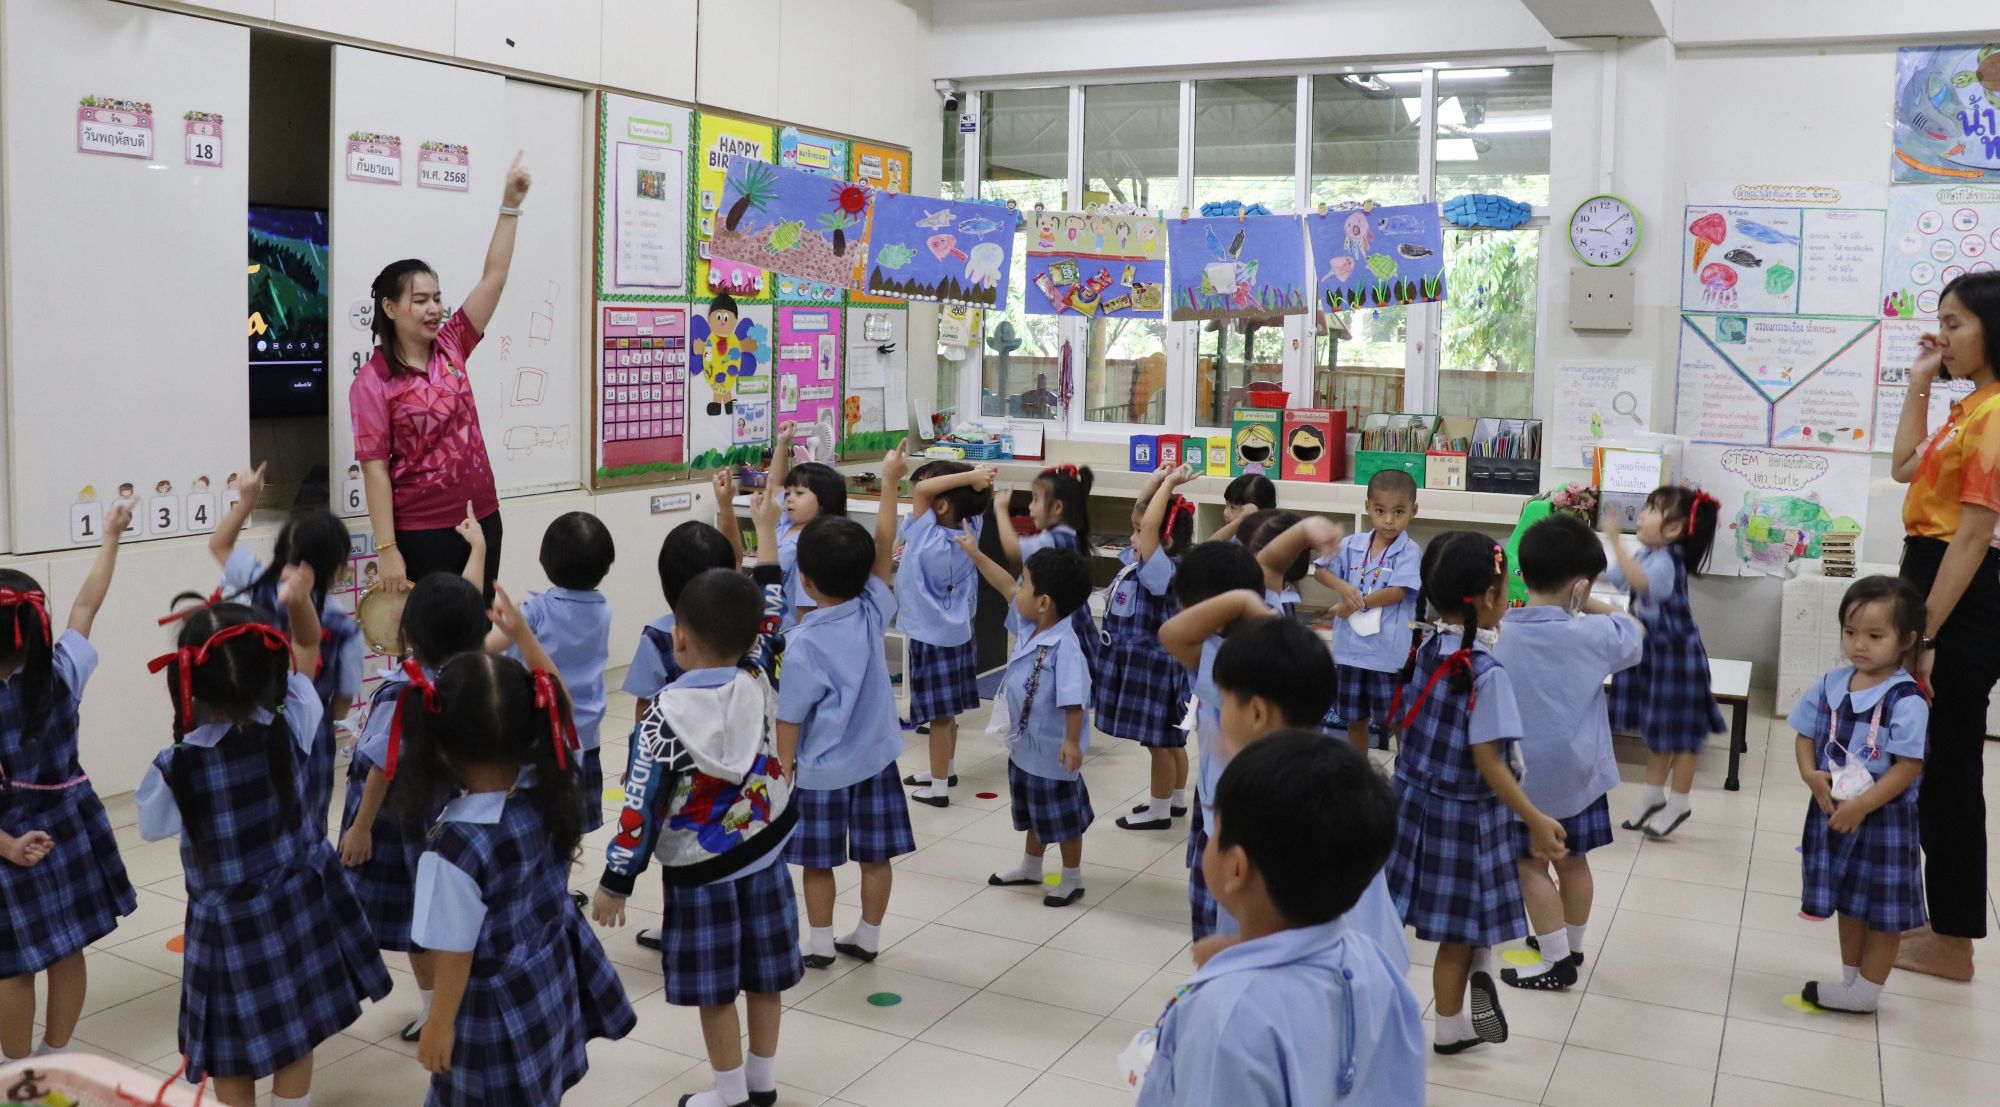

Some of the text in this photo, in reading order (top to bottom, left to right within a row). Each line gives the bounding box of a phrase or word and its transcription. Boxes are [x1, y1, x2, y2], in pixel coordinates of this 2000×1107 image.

[84, 126, 145, 148] วันพฤหัสบดี
[195, 144, 213, 159] 18
[719, 136, 760, 158] HAPPY
[709, 150, 729, 169] BIR
[357, 157, 394, 176] กันยายน
[422, 169, 466, 183] พ.ศ. 2568
[1589, 205, 1597, 213] 11
[1600, 201, 1611, 210] 12
[1580, 214, 1590, 223] 10
[1623, 212, 1630, 220] 2
[1576, 226, 1583, 234] 9
[1626, 226, 1633, 234] 3
[1580, 238, 1587, 247] 8
[1622, 238, 1629, 246] 4
[1589, 248, 1595, 256] 7
[1600, 251, 1608, 259] 6
[1613, 247, 1621, 256] 5
[1726, 453, 1759, 466] STEM
[1774, 473, 1799, 487] turtle
[349, 489, 360, 508] 6
[81, 514, 94, 536] 1
[158, 507, 171, 528] 3
[194, 504, 208, 524] 4
